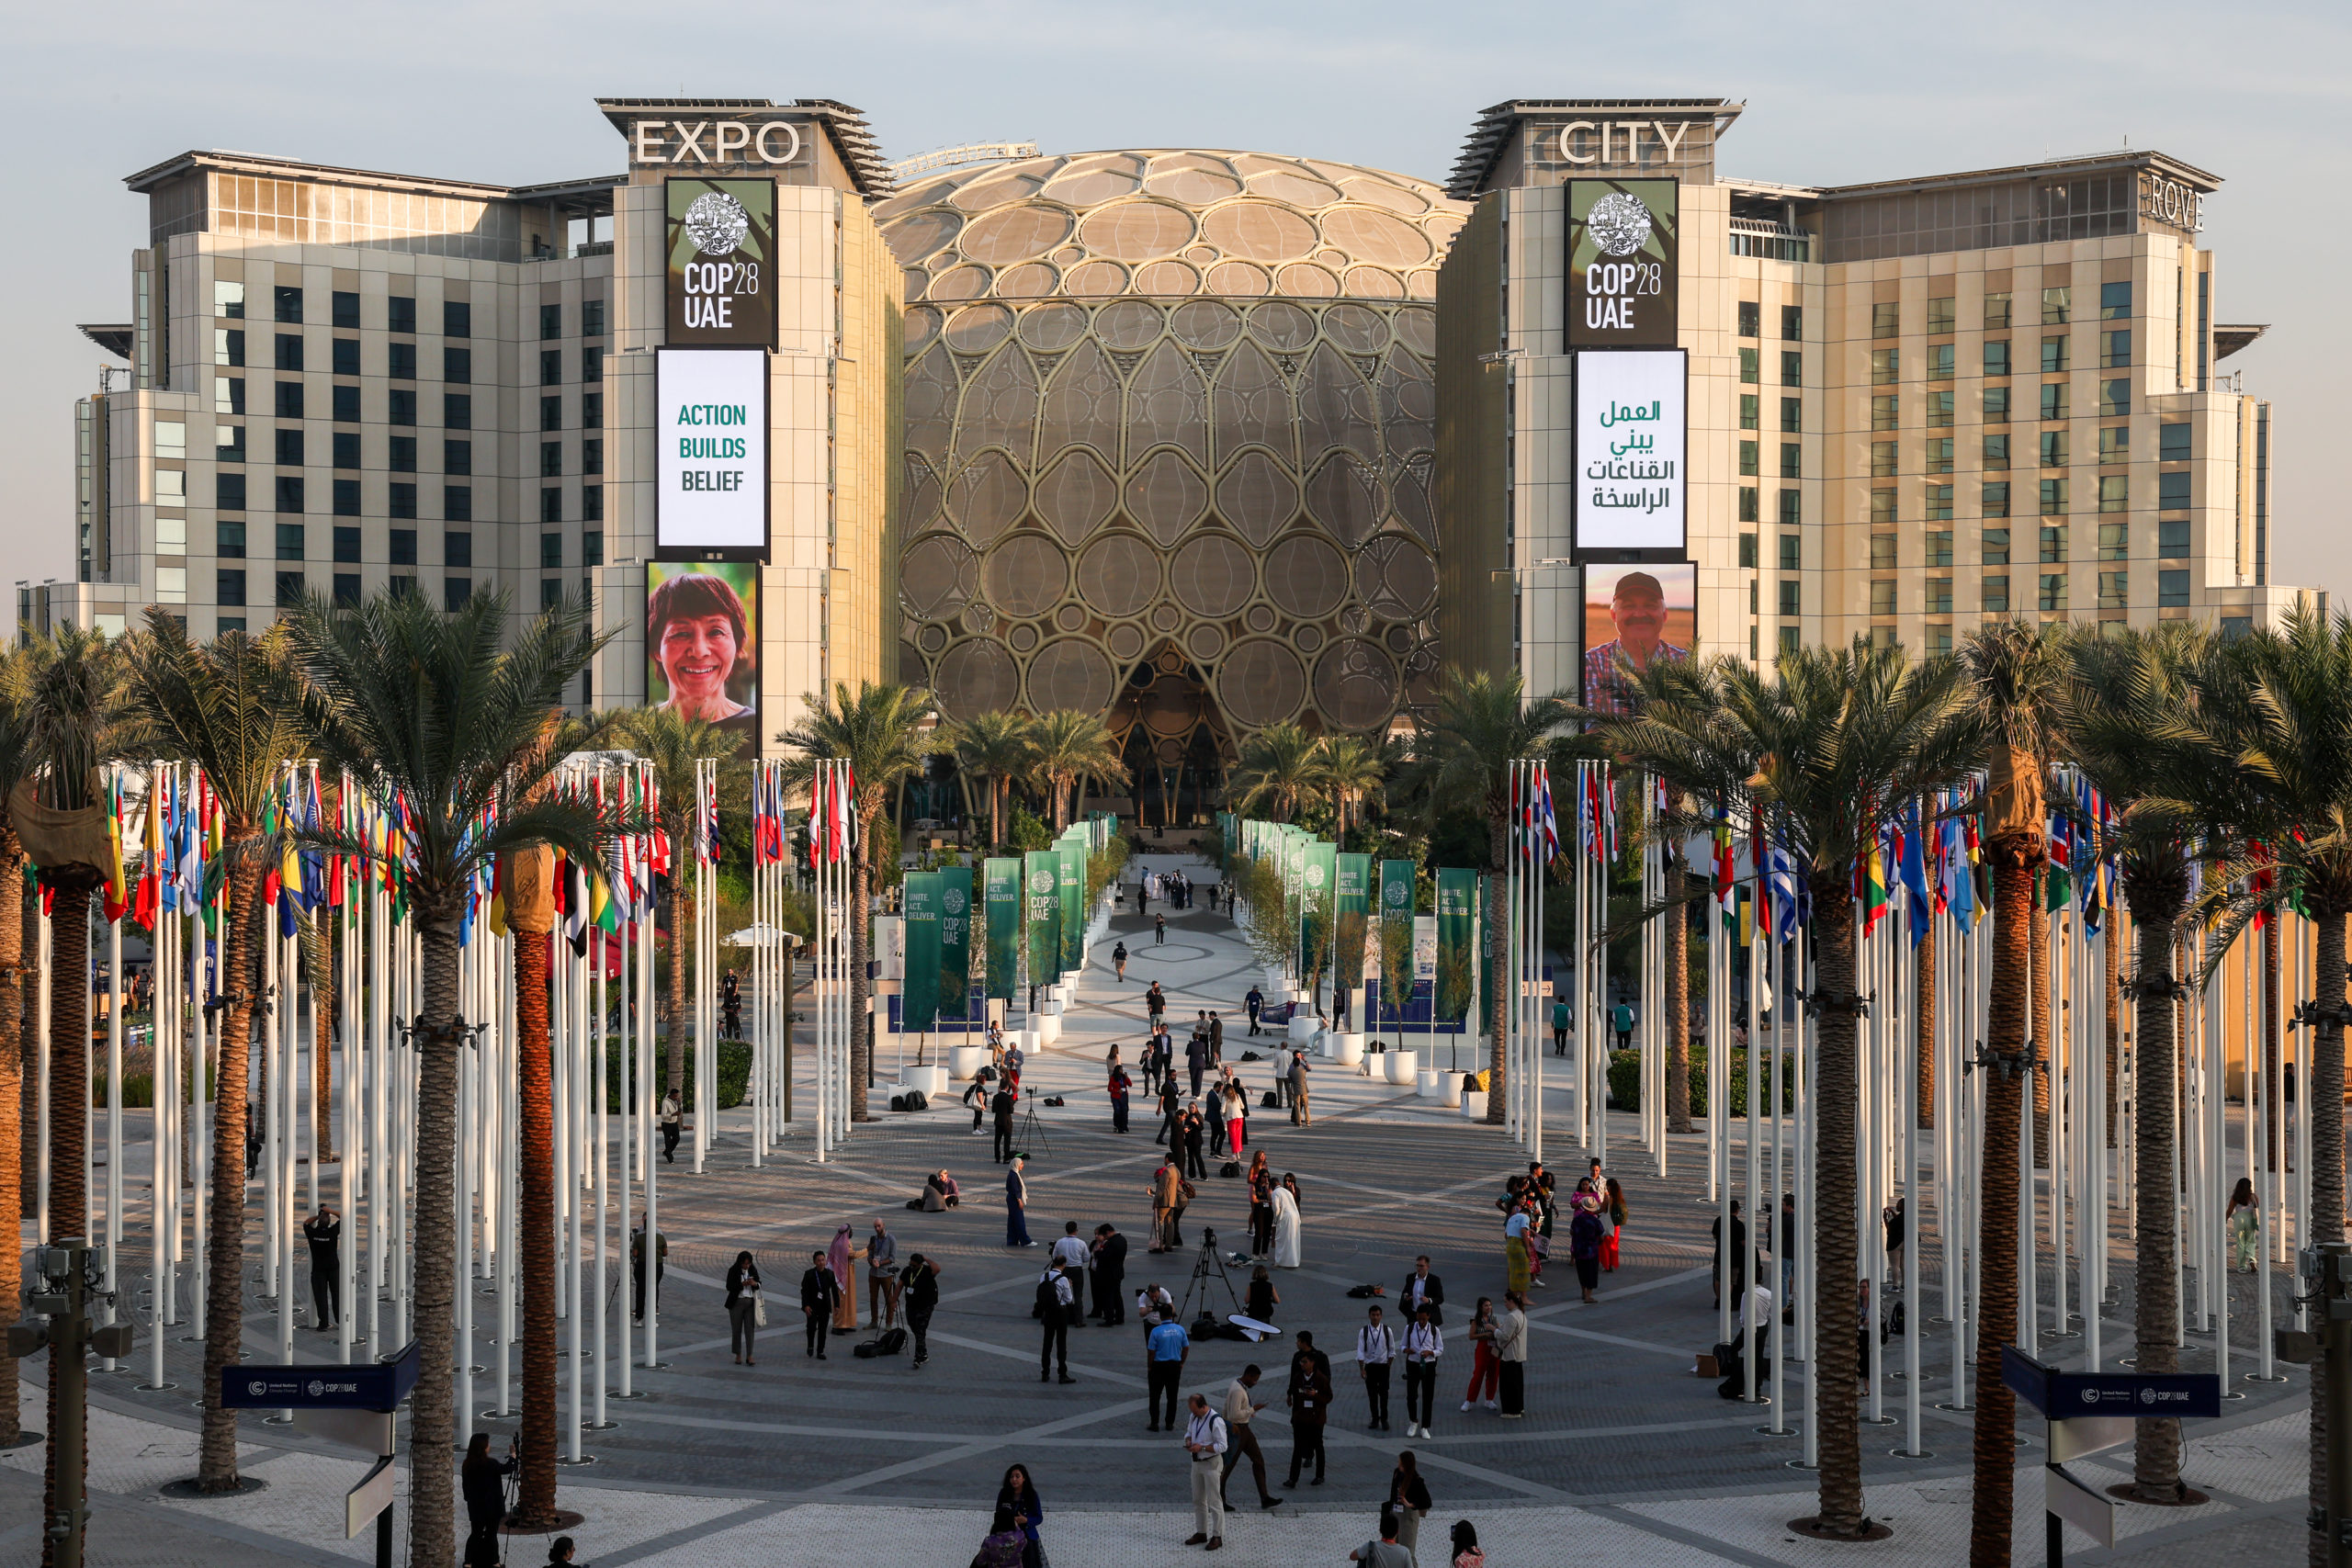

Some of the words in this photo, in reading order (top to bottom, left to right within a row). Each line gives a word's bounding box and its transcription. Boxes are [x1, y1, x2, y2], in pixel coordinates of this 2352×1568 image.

[636, 120, 800, 164] EXPO
[1559, 120, 1690, 164] CITY
[2151, 175, 2204, 232] ROVE
[684, 262, 759, 296] COP28
[1586, 263, 1661, 296] COP28
[684, 296, 733, 329] UAE
[1586, 297, 1634, 330] UAE
[677, 403, 746, 426] ACTION
[1600, 400, 1660, 428] العمل
[679, 437, 746, 459] BUILDS
[1610, 429, 1654, 460] يبني
[1587, 459, 1674, 480] القناعات
[682, 470, 743, 492] BELIEF
[1592, 487, 1670, 514] الراسخة
[909, 893, 930, 901] UNITE.
[989, 893, 1015, 901] DELIVER.
[1031, 896, 1058, 908] COP28
[1340, 887, 1365, 896] DELIVER.
[1441, 888, 1463, 897] UNITE.
[1441, 897, 1455, 906] ACT.
[908, 902, 922, 911] ACT.
[908, 911, 937, 920] DELIVER.
[1031, 908, 1049, 921] UAE
[1441, 906, 1469, 915] DELIVER.
[943, 917, 967, 931] COP28
[943, 931, 959, 945] UAE
